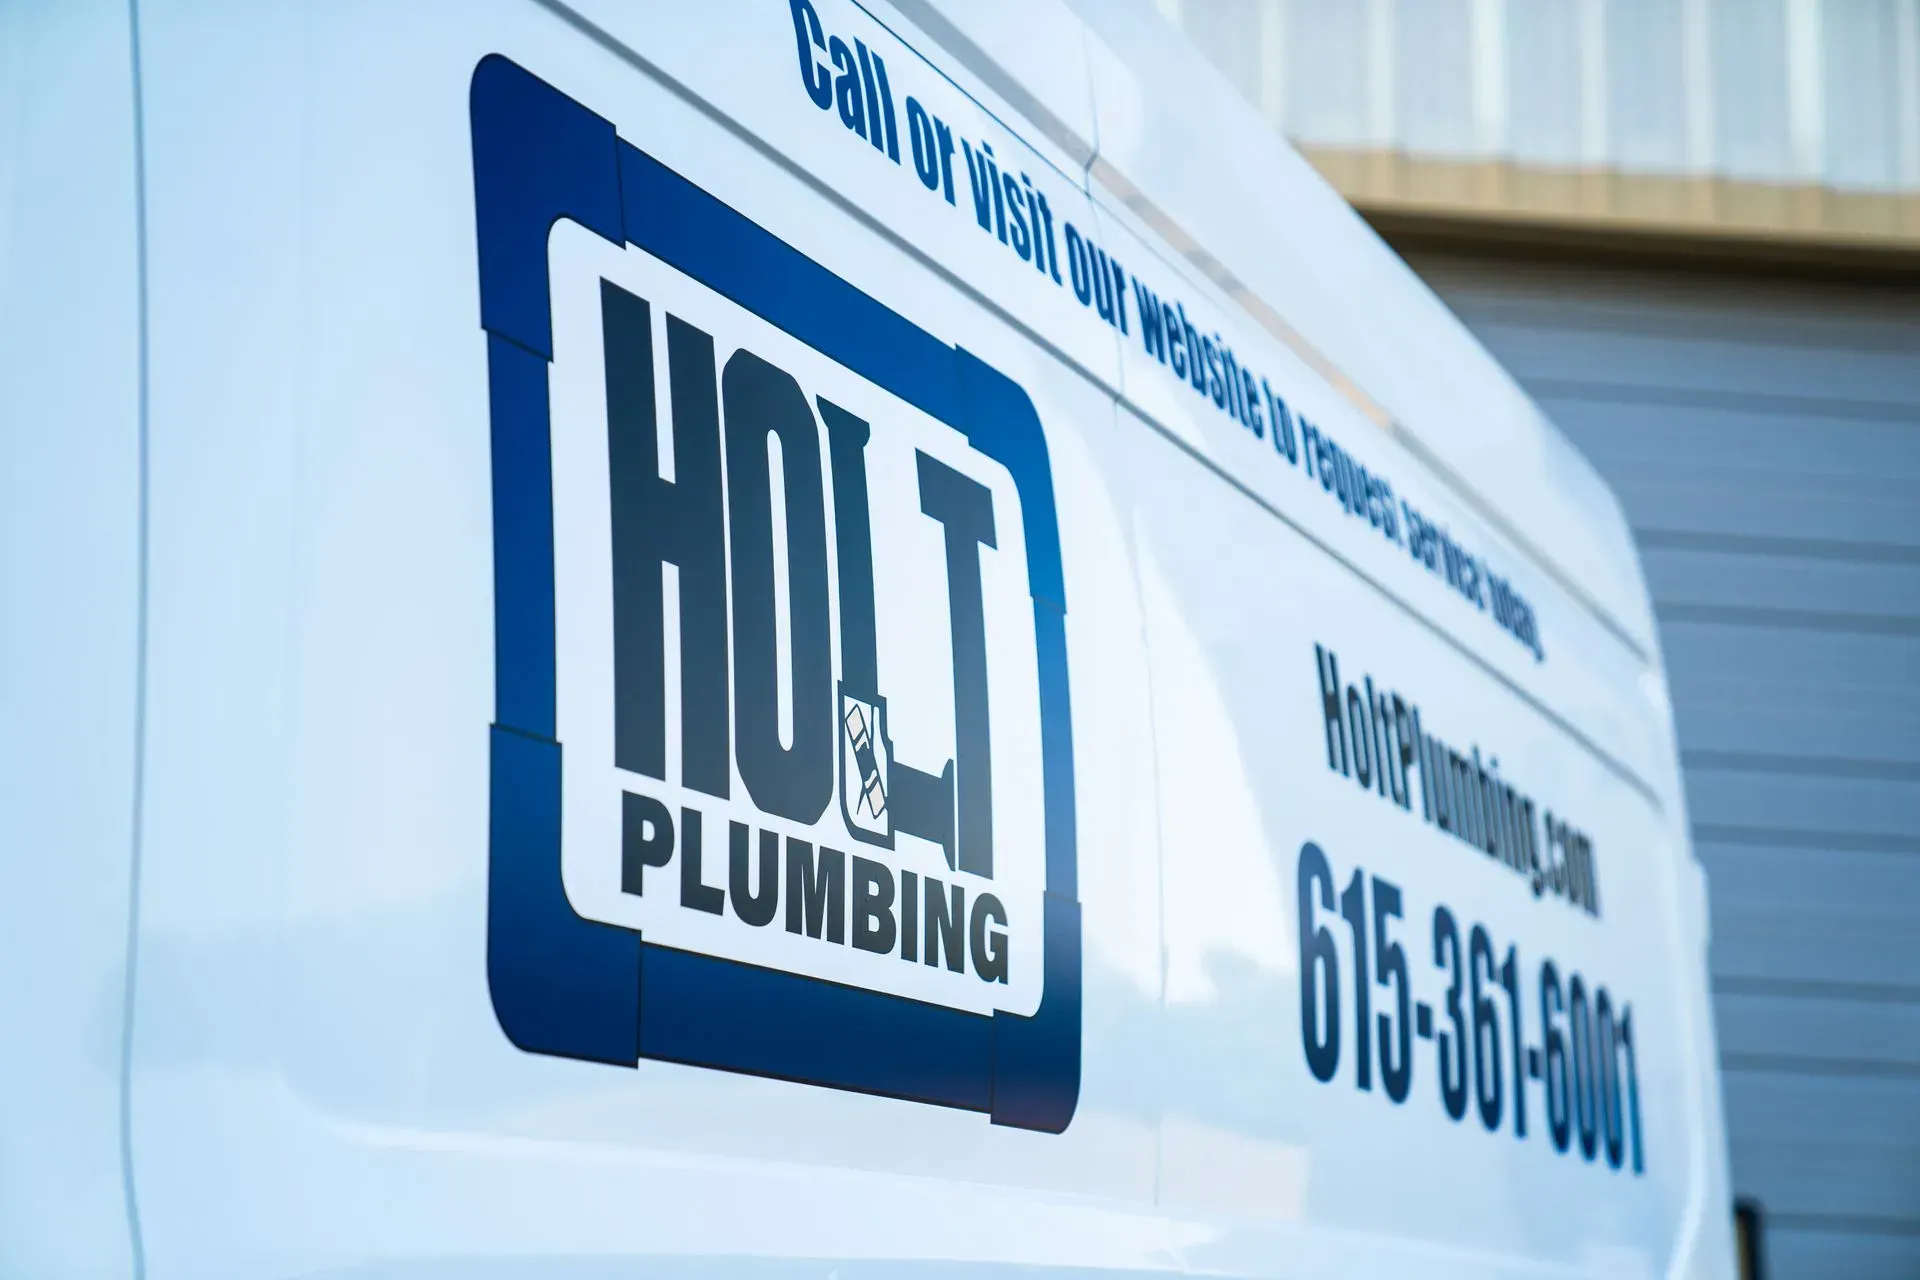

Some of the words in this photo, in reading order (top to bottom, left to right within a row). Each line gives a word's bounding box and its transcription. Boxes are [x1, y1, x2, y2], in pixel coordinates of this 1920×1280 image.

[789, 0, 900, 165] Call
[906, 96, 956, 207] or
[960, 136, 1063, 286] visit
[1064, 221, 1128, 337] our
[1131, 273, 1264, 440] website
[1262, 375, 1298, 465] to
[1299, 410, 1404, 548] request
[600, 276, 999, 880] HOLT
[621, 790, 1010, 985] PLUMBING
[1314, 641, 1601, 921] HoltPlumbing.com
[1297, 840, 1646, 1176] 615-361-6001
